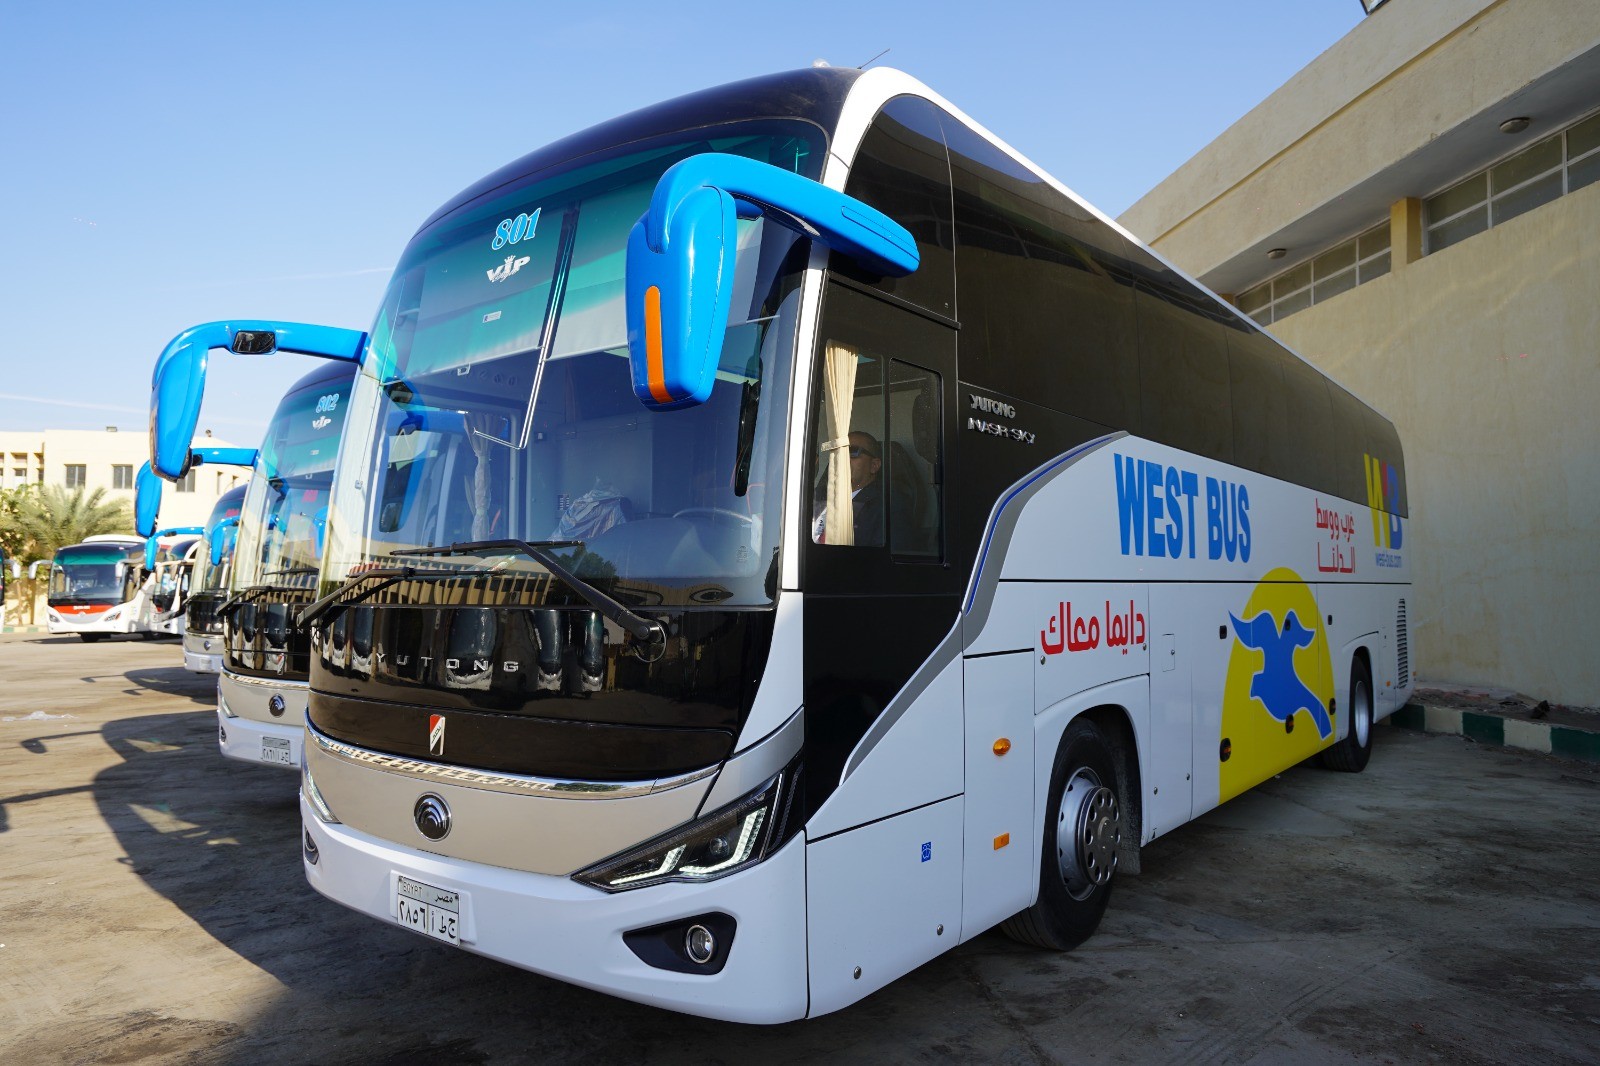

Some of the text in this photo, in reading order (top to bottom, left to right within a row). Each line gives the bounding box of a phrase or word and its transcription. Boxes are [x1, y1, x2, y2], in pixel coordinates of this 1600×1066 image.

[491, 206, 542, 251] 801
[968, 393, 1016, 419] YUTONG
[1113, 452, 1251, 564] WEST BUS
[1040, 599, 1146, 656] دايما معاك
[376, 653, 520, 673] YUTONG
[403, 881, 423, 898] EGYPT
